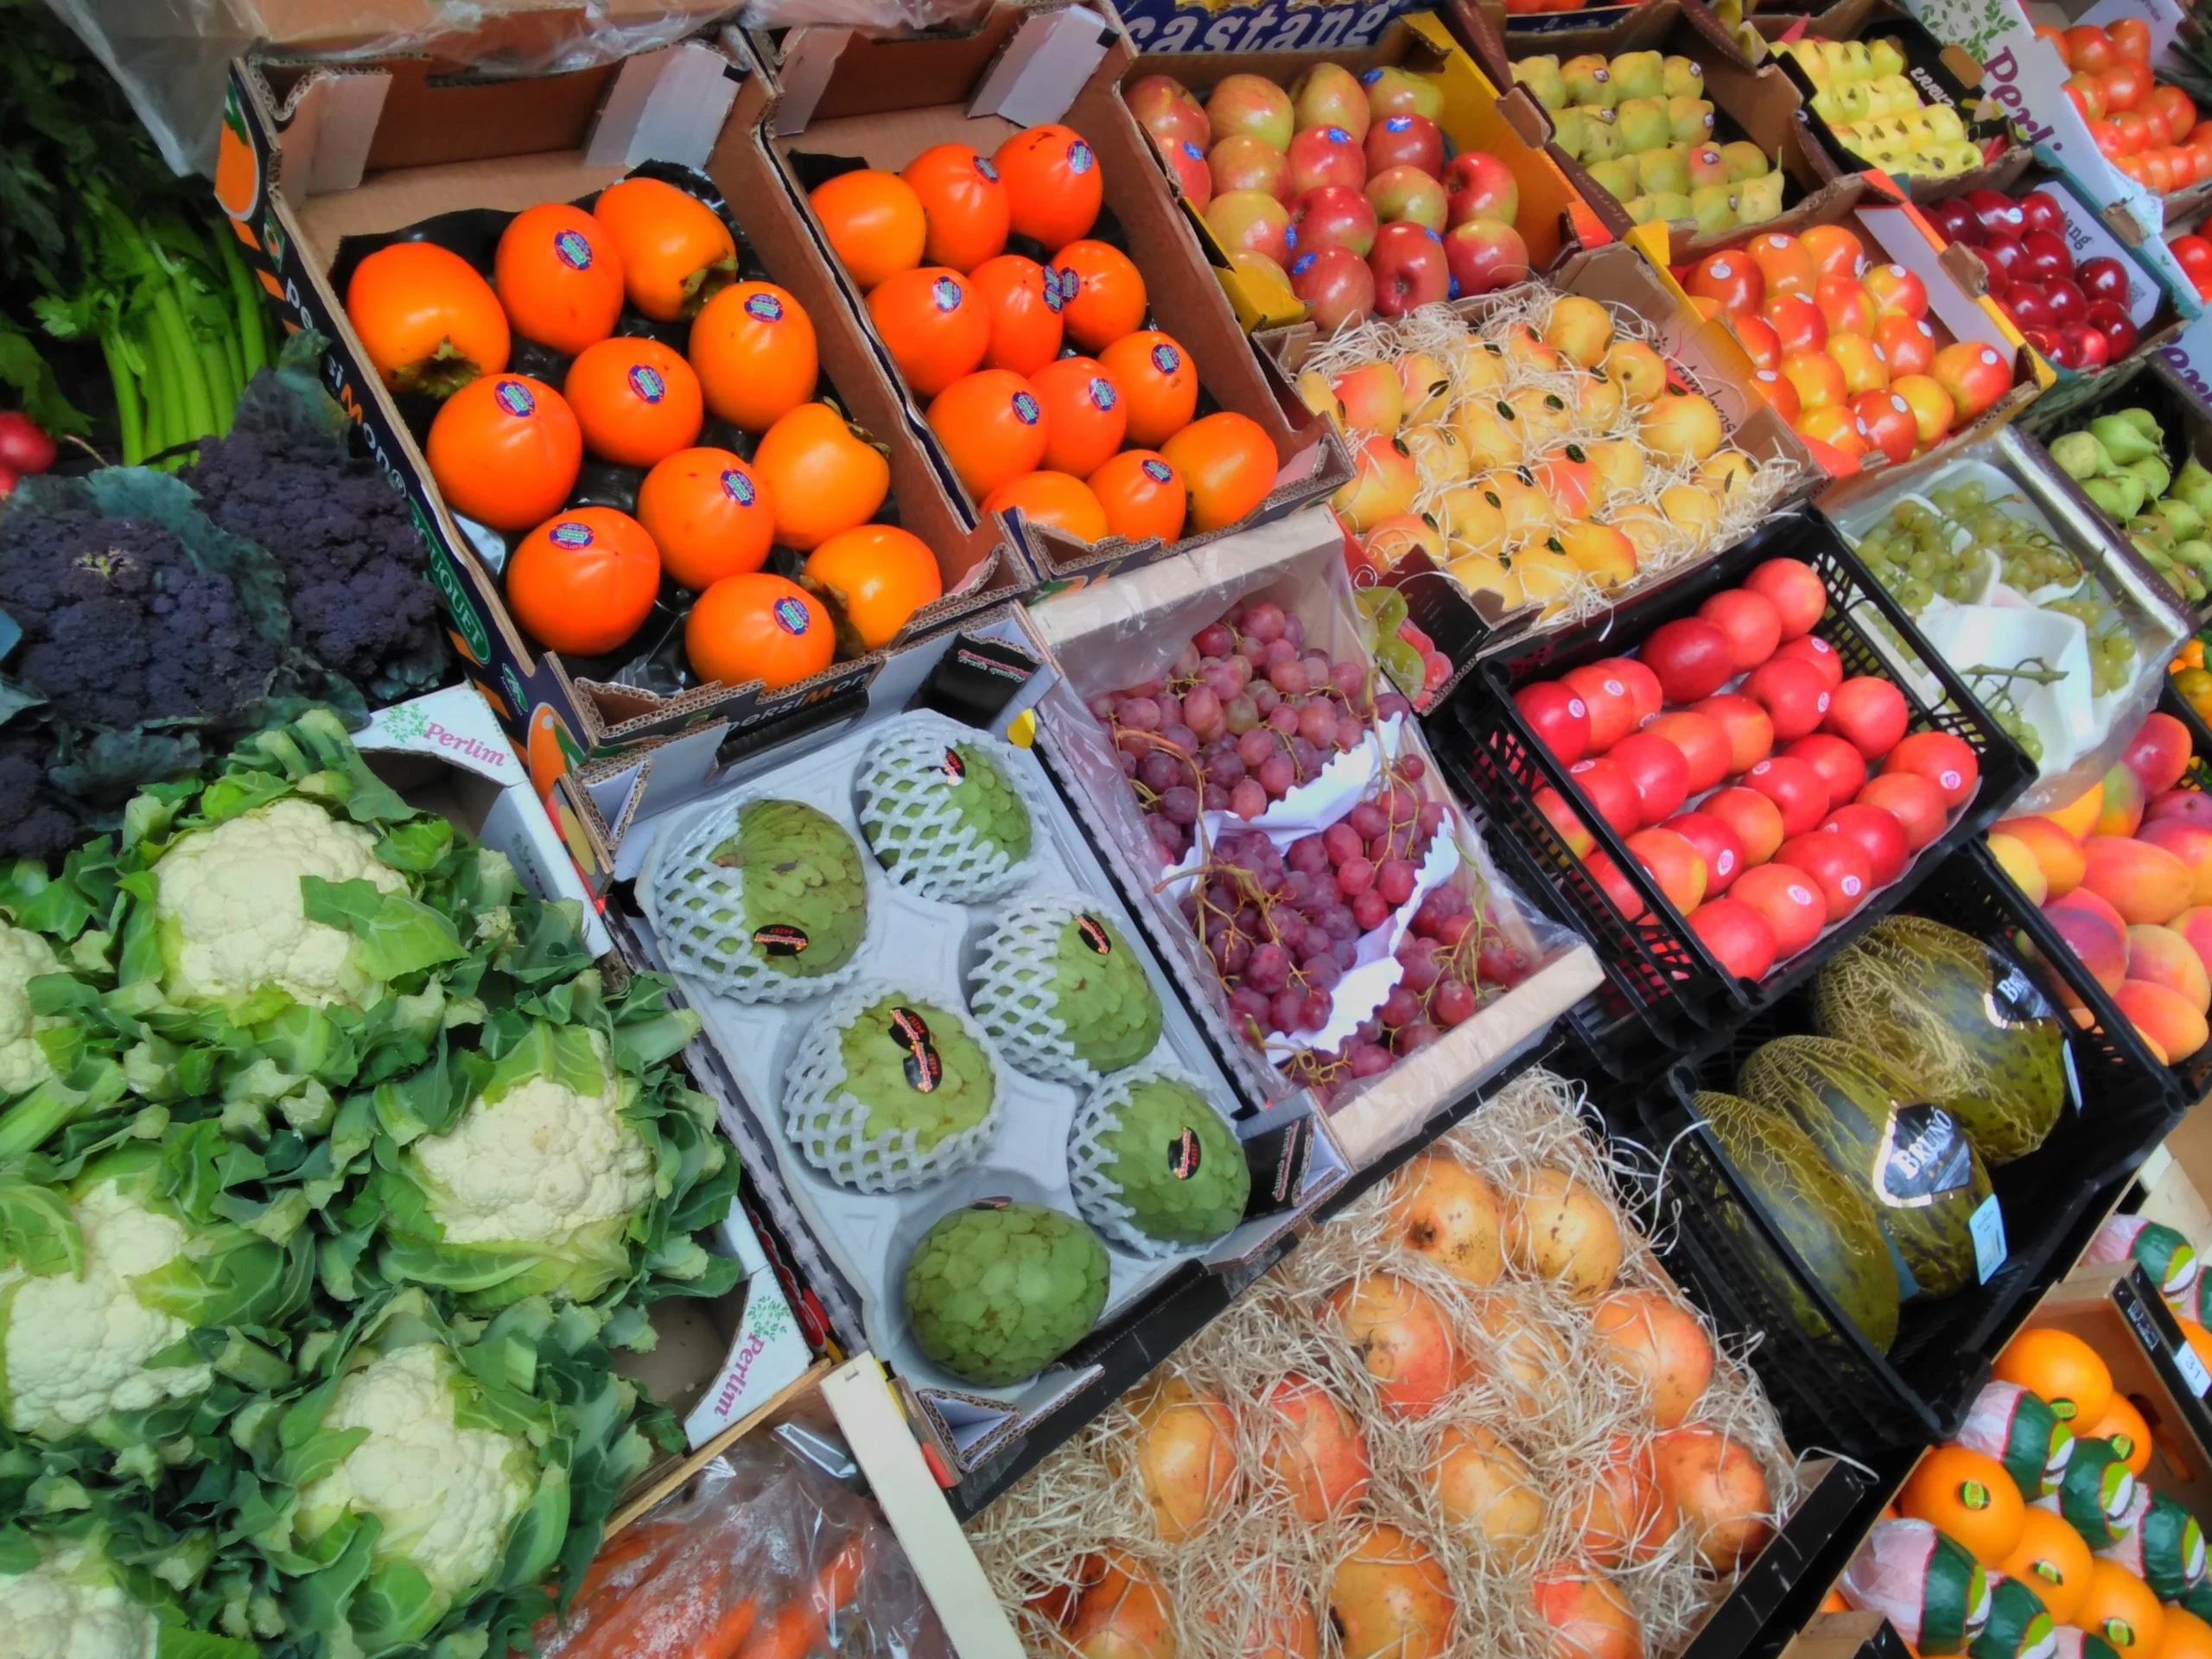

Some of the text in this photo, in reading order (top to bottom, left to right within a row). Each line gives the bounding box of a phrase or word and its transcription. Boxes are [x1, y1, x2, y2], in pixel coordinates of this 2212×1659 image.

[1982, 45, 2063, 151] Perl
[423, 721, 505, 767] Perlim
[714, 1332, 766, 1417] Perlim
